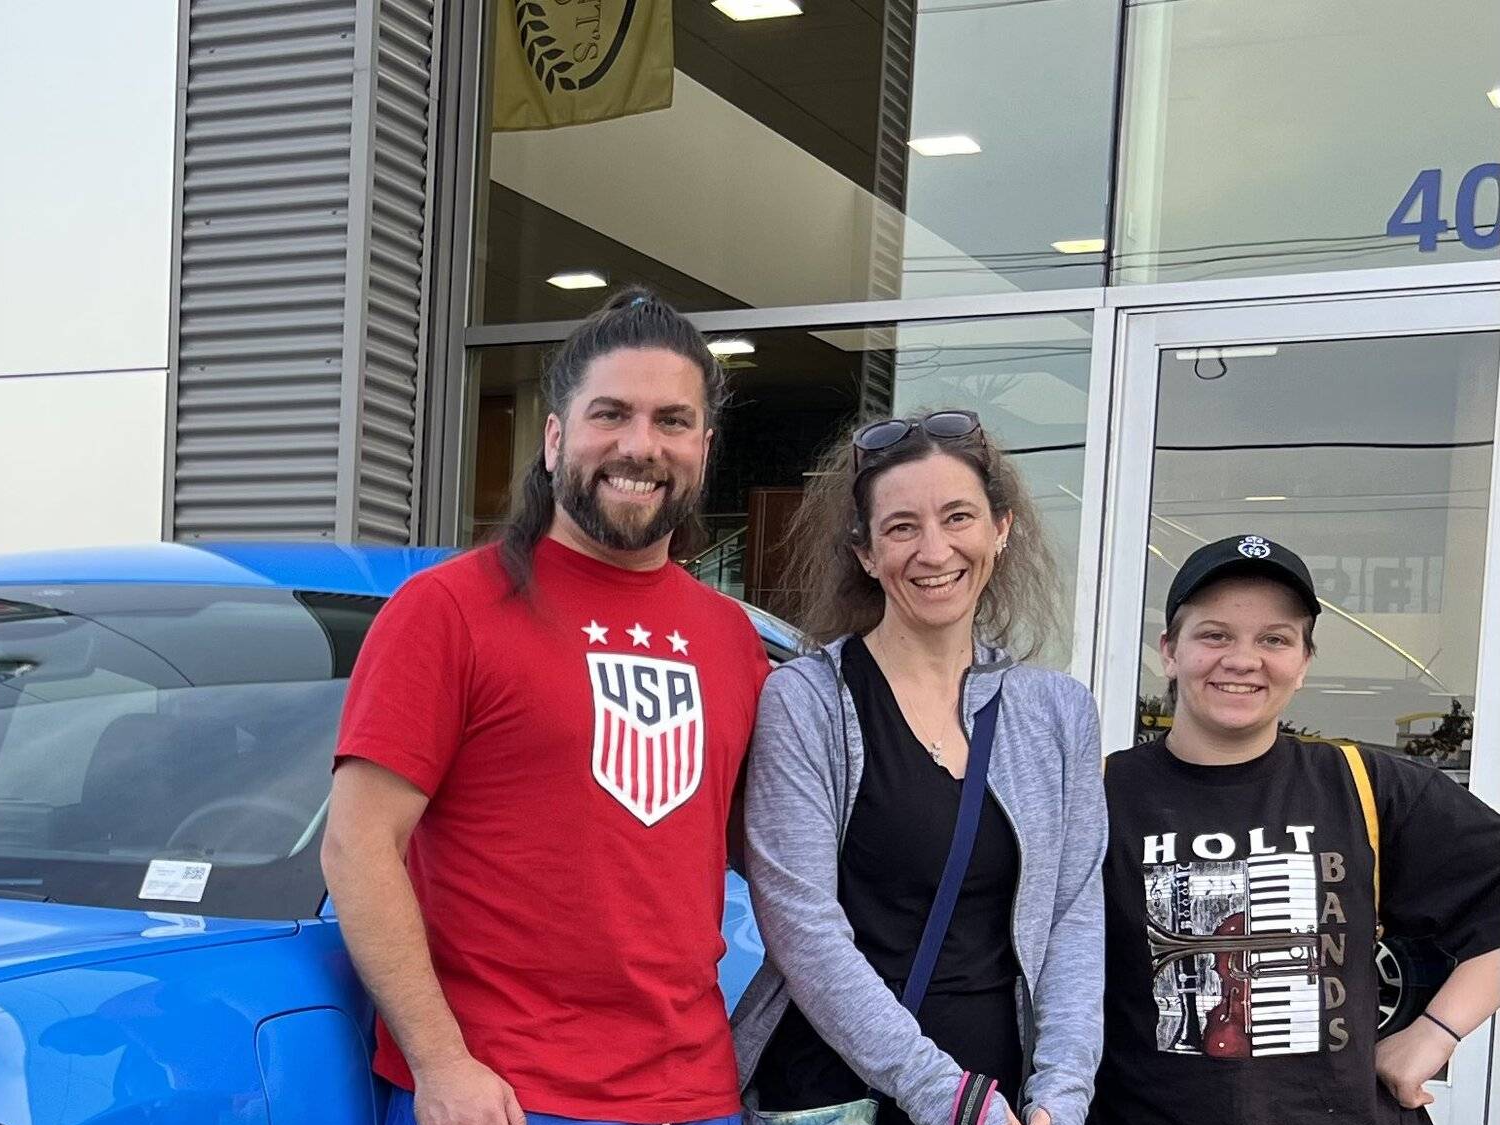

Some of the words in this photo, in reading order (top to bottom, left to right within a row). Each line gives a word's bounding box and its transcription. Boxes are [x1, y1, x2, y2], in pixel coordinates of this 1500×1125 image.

[1385, 163, 1500, 253] 40
[596, 662, 694, 727] USA
[1142, 825, 1316, 864] HOLT
[1319, 852, 1349, 1051] BANDS
